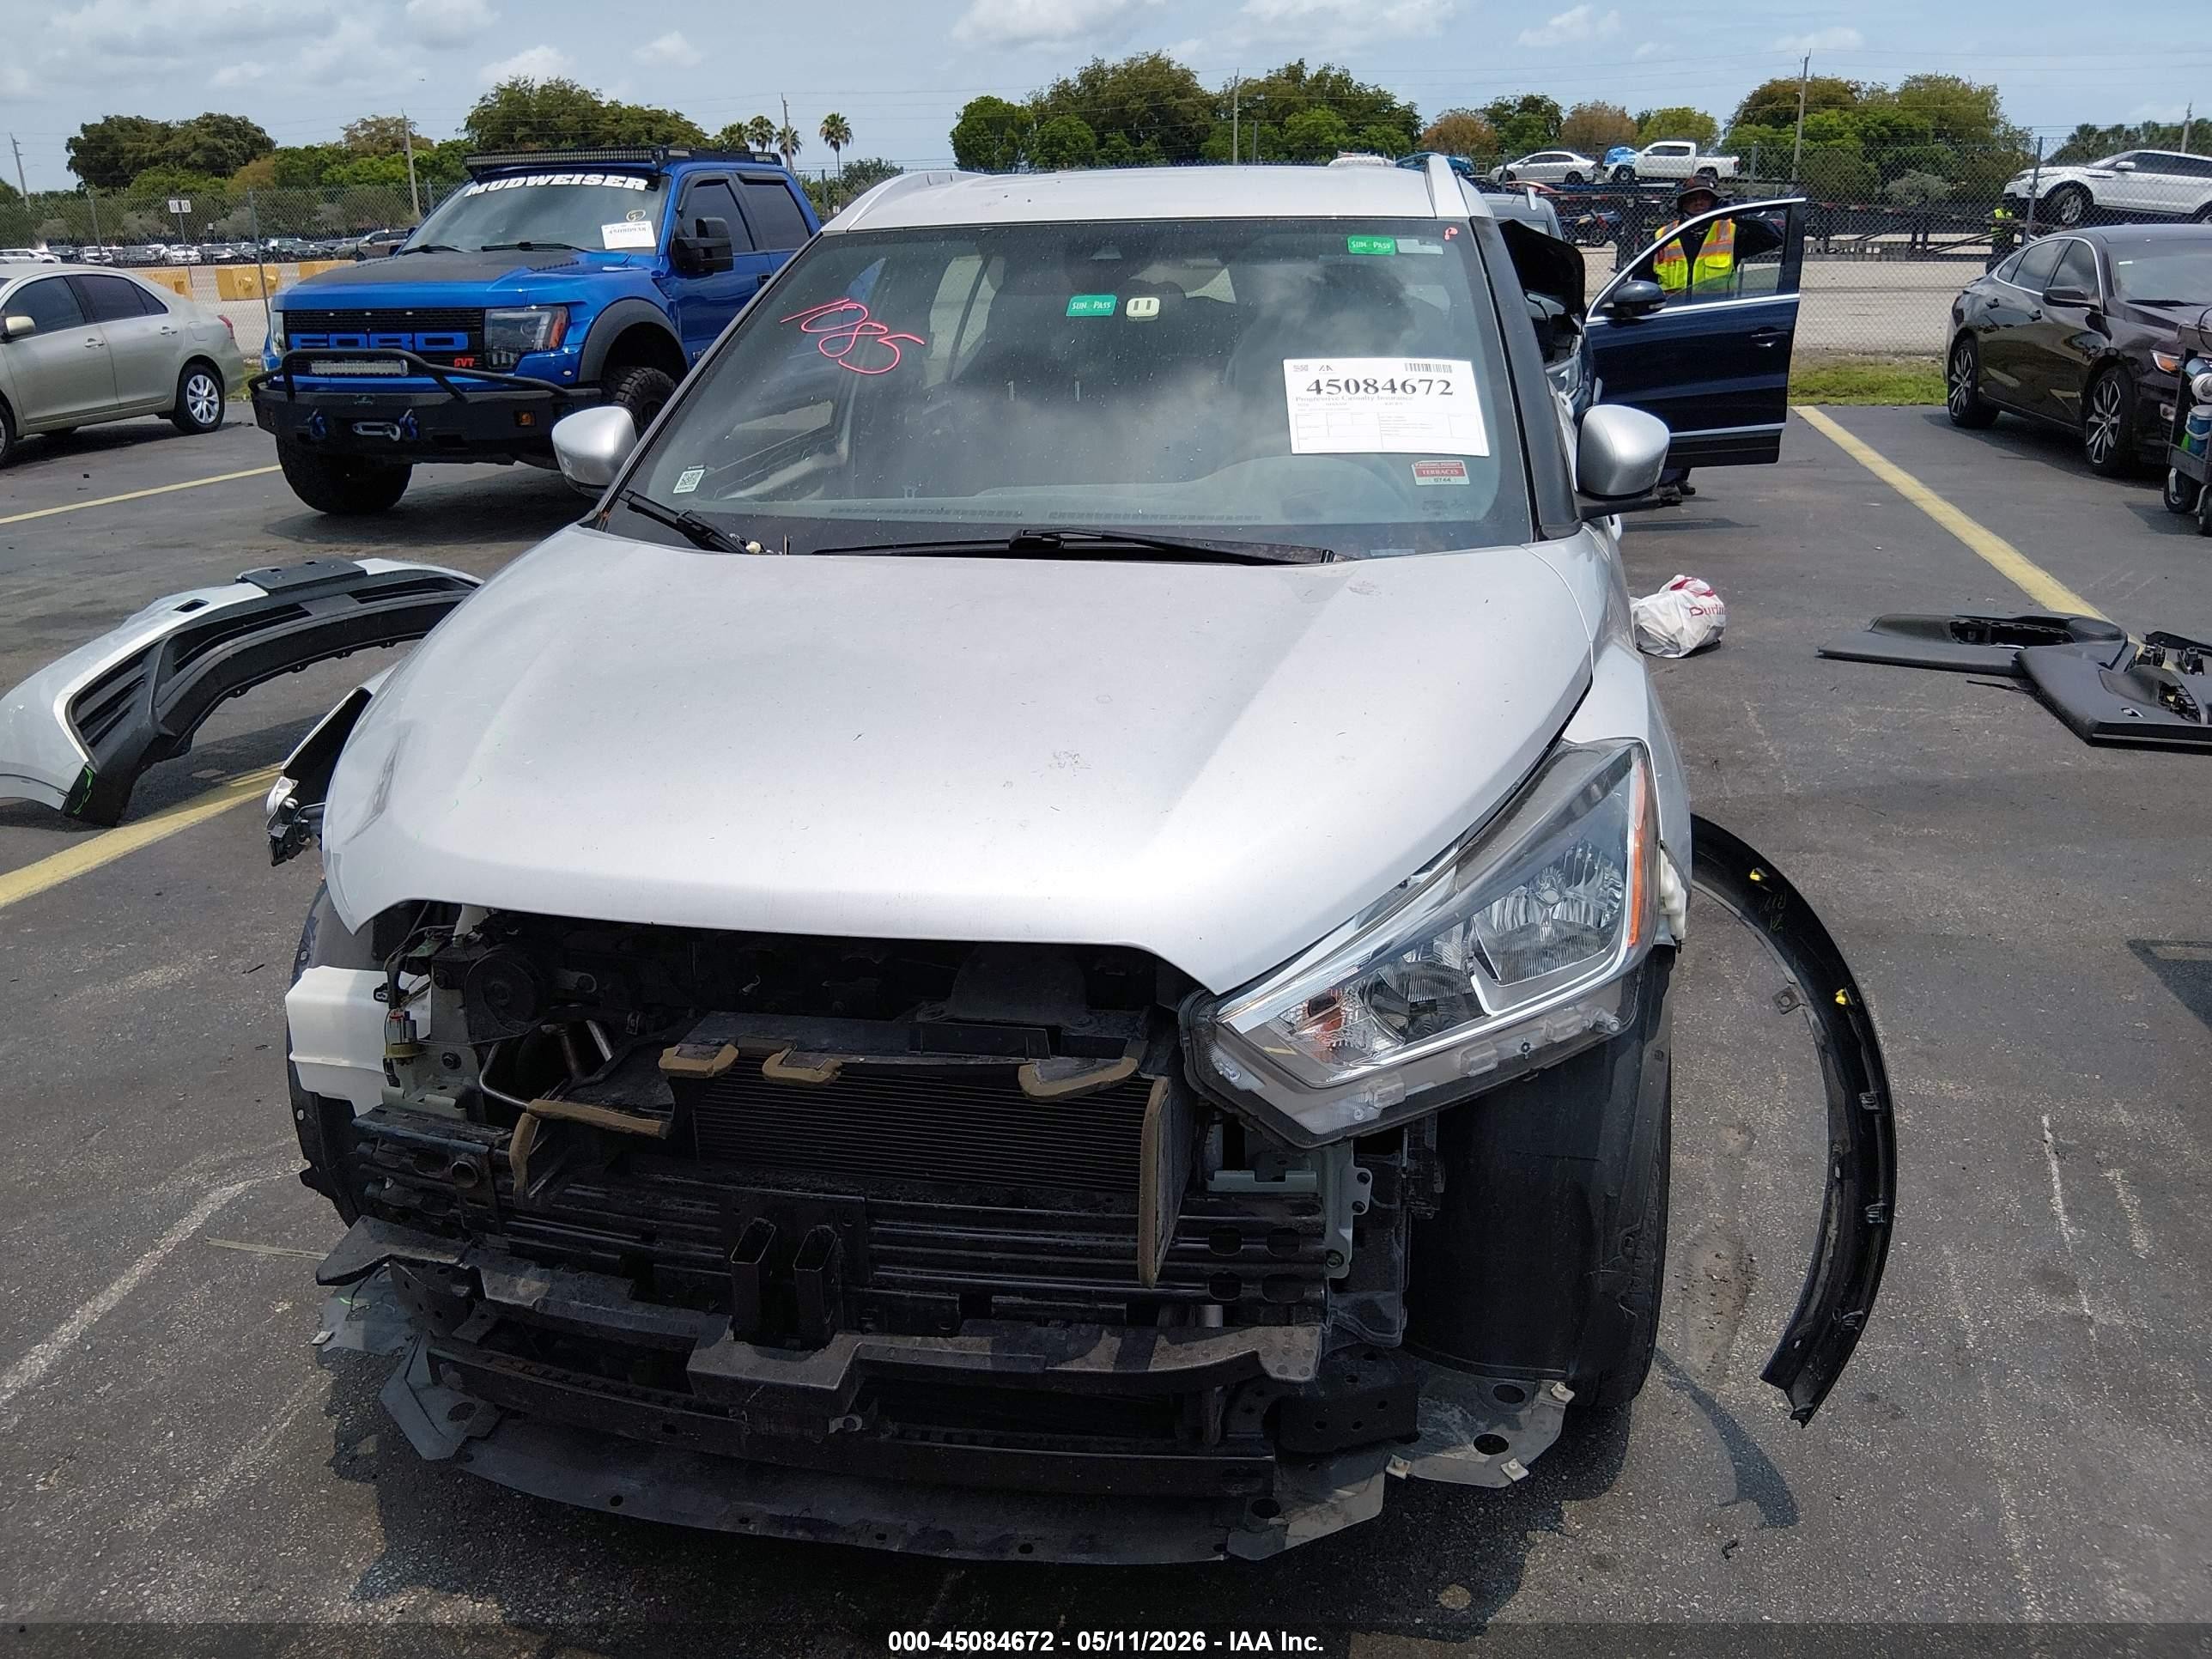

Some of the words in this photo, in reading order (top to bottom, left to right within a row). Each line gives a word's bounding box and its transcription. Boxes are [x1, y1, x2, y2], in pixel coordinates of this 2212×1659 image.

[464, 174, 647, 197] MUDWEISER
[1072, 301, 1087, 310] SUN
[289, 332, 469, 351] FORD
[779, 298, 925, 374] 1085
[453, 357, 475, 368] SVT
[1306, 377, 1455, 396] 45084672
